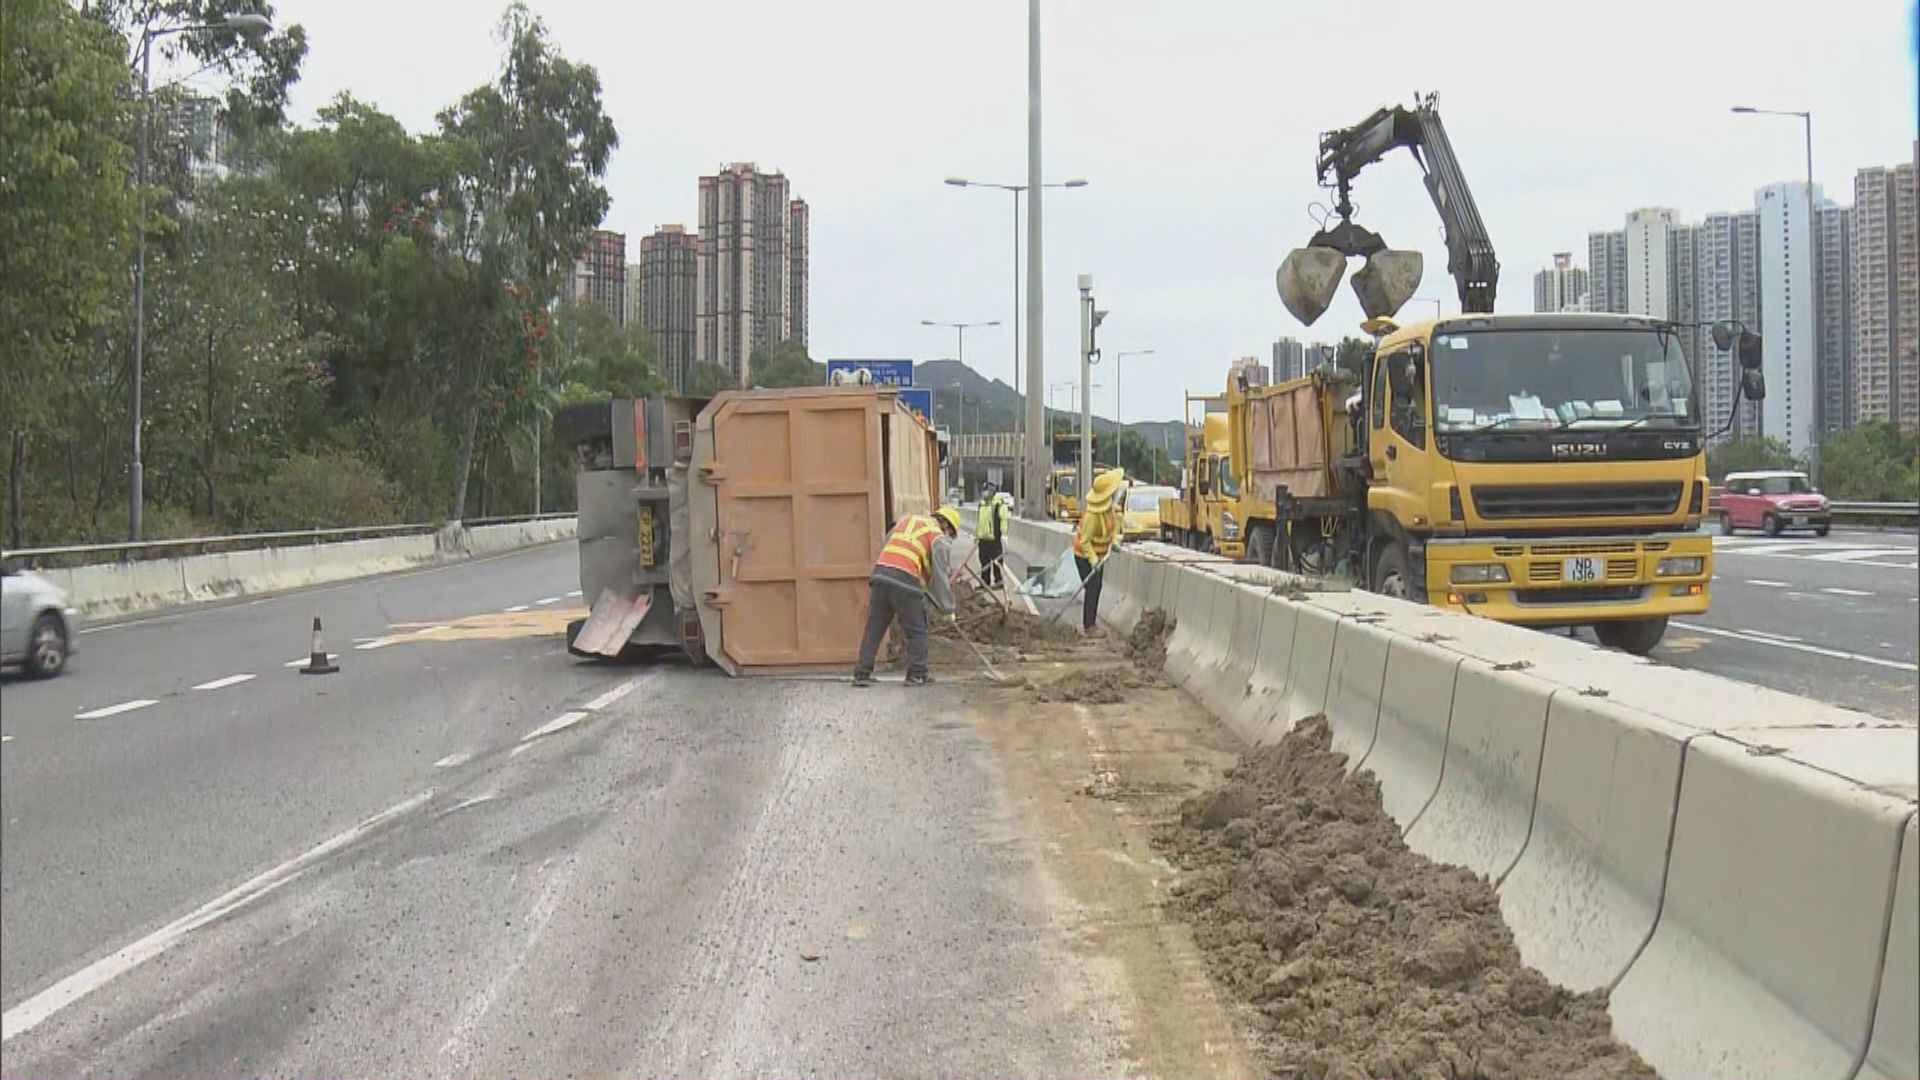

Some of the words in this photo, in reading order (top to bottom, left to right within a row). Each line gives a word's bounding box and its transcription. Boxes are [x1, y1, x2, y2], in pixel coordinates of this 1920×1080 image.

[1551, 443, 1607, 456] ISUZU
[1575, 557, 1592, 569] ND
[1572, 569, 1595, 581] 1316
